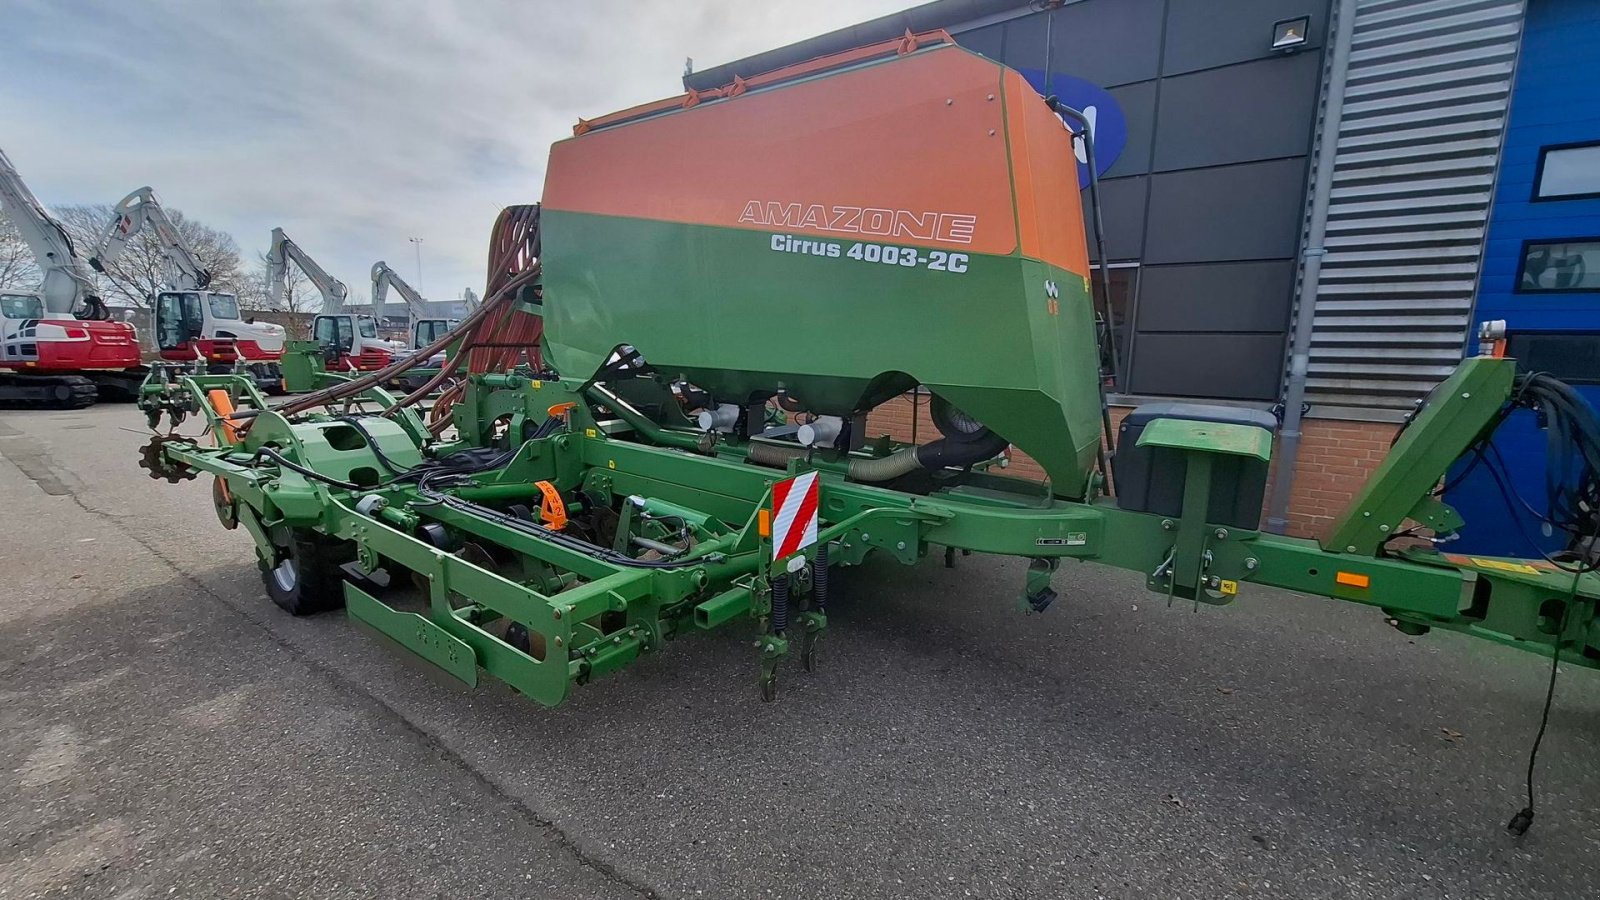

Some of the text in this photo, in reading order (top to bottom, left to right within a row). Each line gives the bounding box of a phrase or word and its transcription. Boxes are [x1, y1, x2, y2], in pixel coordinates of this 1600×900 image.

[738, 200, 976, 243] AMAZONE
[770, 234, 969, 274] Cirrus 4003-2C
